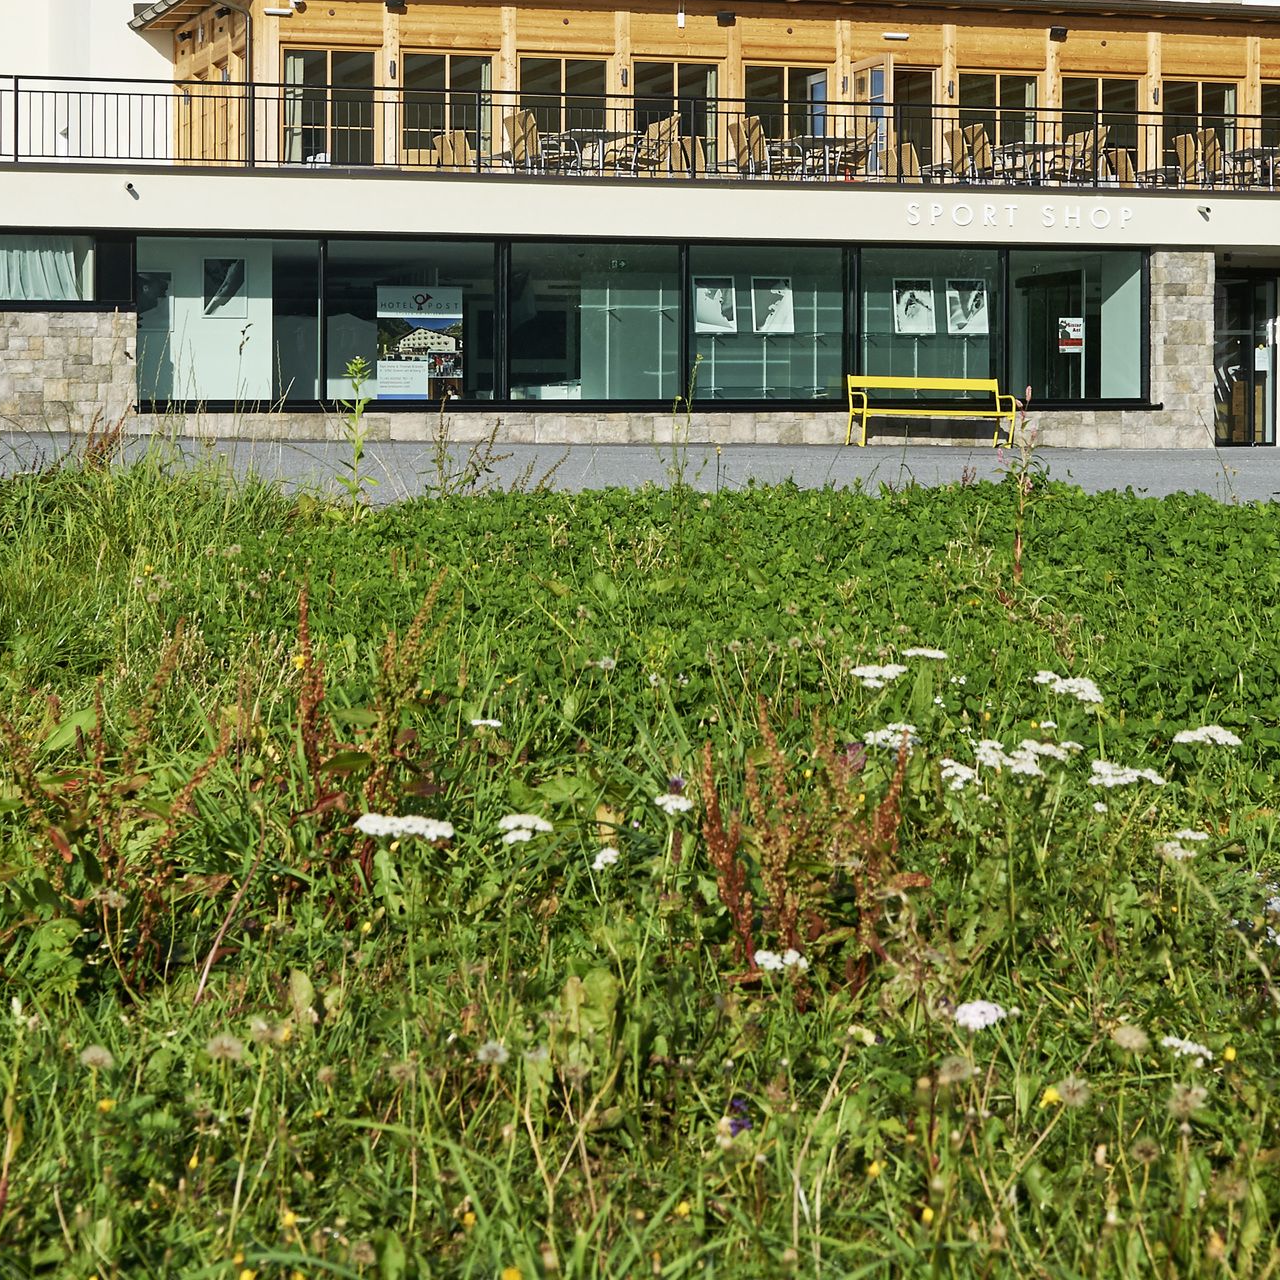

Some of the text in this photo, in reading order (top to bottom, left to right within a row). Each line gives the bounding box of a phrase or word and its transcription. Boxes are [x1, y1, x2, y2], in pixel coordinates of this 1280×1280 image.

[906, 202, 1133, 230] SPORT SHOP
[428, 302, 459, 310] POST
